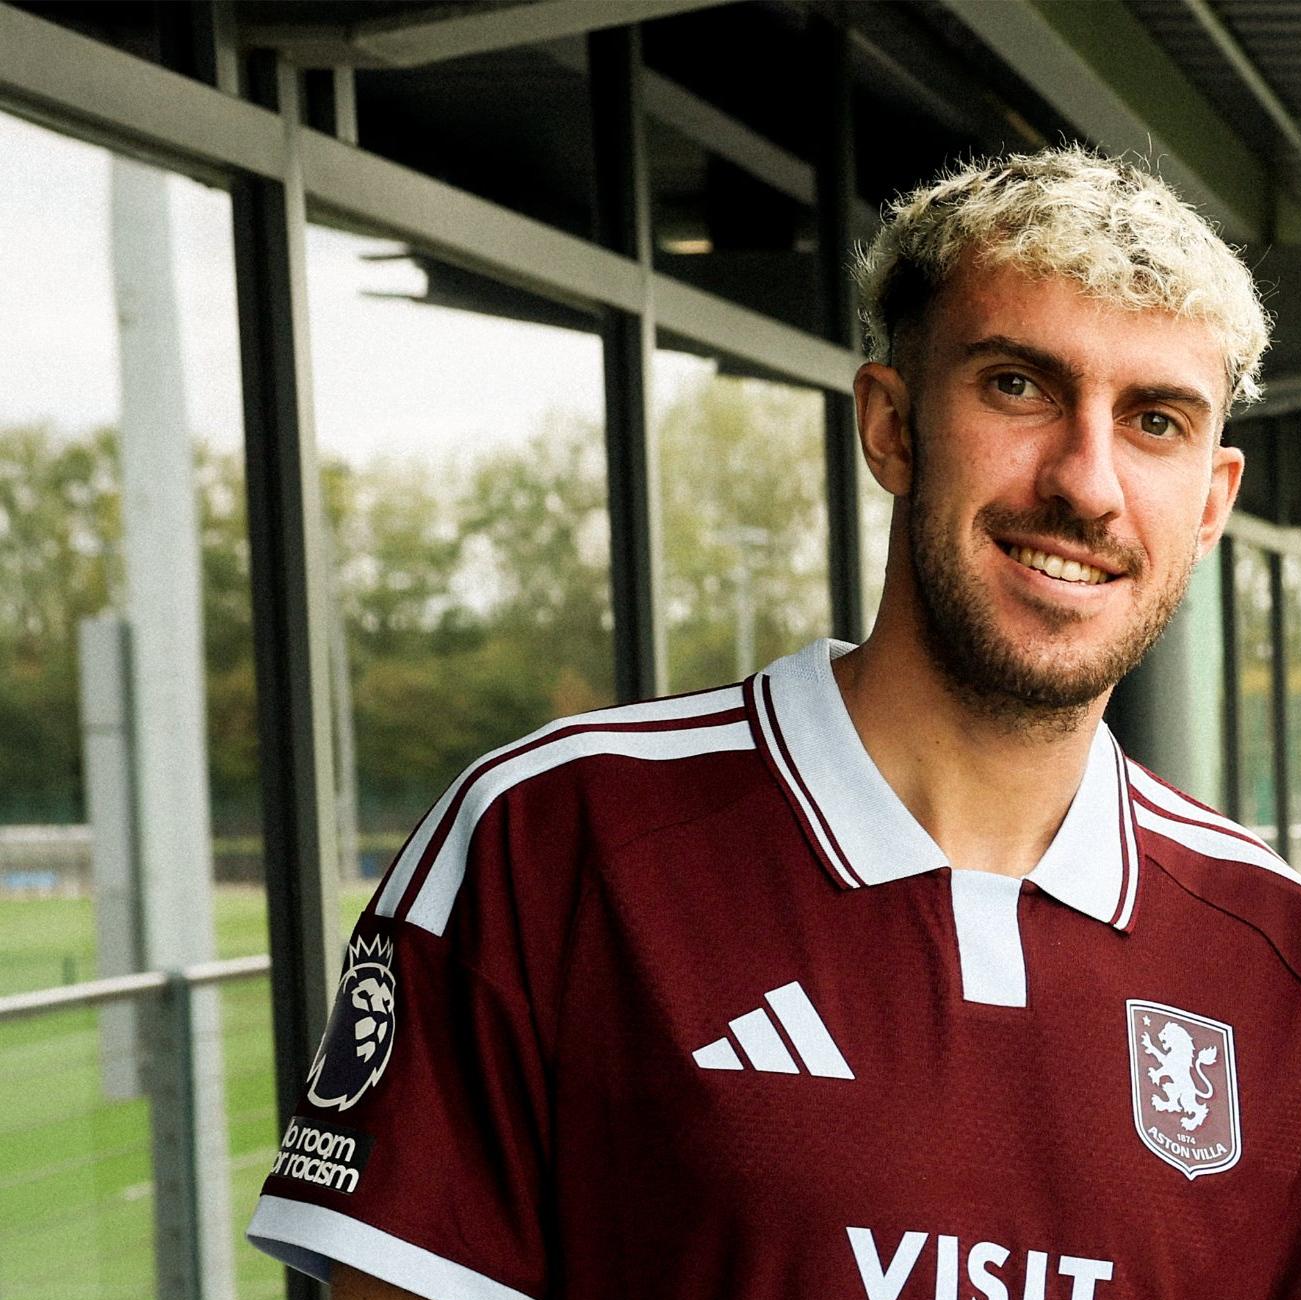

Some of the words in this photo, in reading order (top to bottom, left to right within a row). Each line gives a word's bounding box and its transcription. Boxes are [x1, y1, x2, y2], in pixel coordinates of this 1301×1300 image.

[296, 1127, 356, 1162] room
[1147, 1126, 1190, 1159] ASTON
[1191, 1142, 1228, 1161] VILLA
[1176, 1133, 1197, 1145] 1874
[284, 1153, 360, 1193] racism
